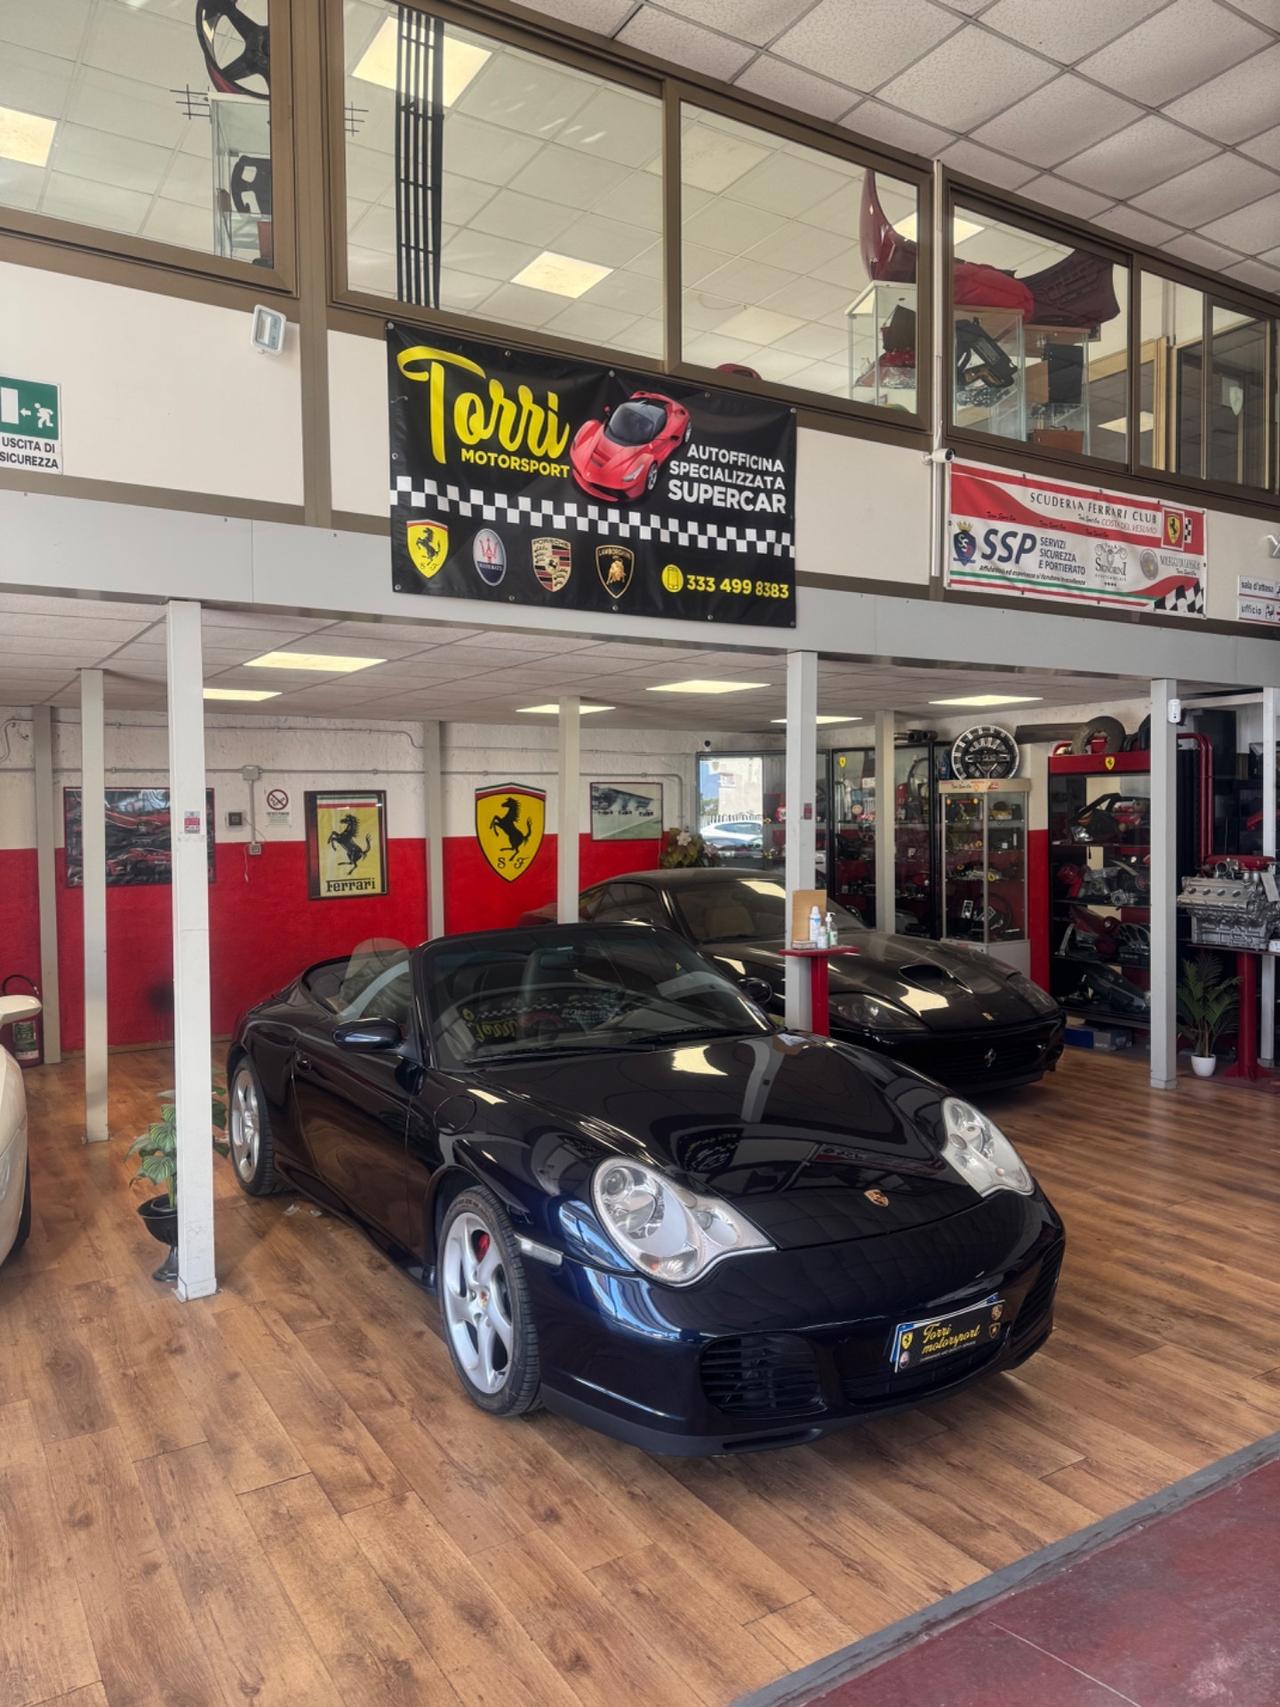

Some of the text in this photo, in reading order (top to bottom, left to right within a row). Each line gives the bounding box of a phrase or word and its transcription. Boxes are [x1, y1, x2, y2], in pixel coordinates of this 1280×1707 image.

[397, 345, 570, 464] Torri
[1, 436, 55, 453] USCITA DI
[0, 452, 59, 469] SICUREZZA
[461, 448, 570, 478] MOTORSPORT
[687, 443, 785, 473] AUTOFFICINA
[669, 460, 786, 490] SPECIALIZZATA
[668, 479, 786, 514] SUPERCAR
[1030, 492, 1084, 512] SCUDERIA
[1088, 502, 1128, 519] FERRARI
[1132, 511, 1157, 524] CLUB
[981, 528, 1037, 565] SSP
[1040, 536, 1066, 549] SERVIZI
[1040, 548, 1077, 563] SICUREZZA
[1038, 559, 1086, 575] E PORTIERATO
[687, 574, 789, 599] 333 499 8383
[1241, 580, 1252, 590] sala
[1241, 603, 1262, 615] ufficio
[497, 856, 530, 869] S F
[326, 877, 376, 892] Ferrari
[921, 1323, 981, 1355] motorsport
[923, 1322, 952, 1344] Torri
